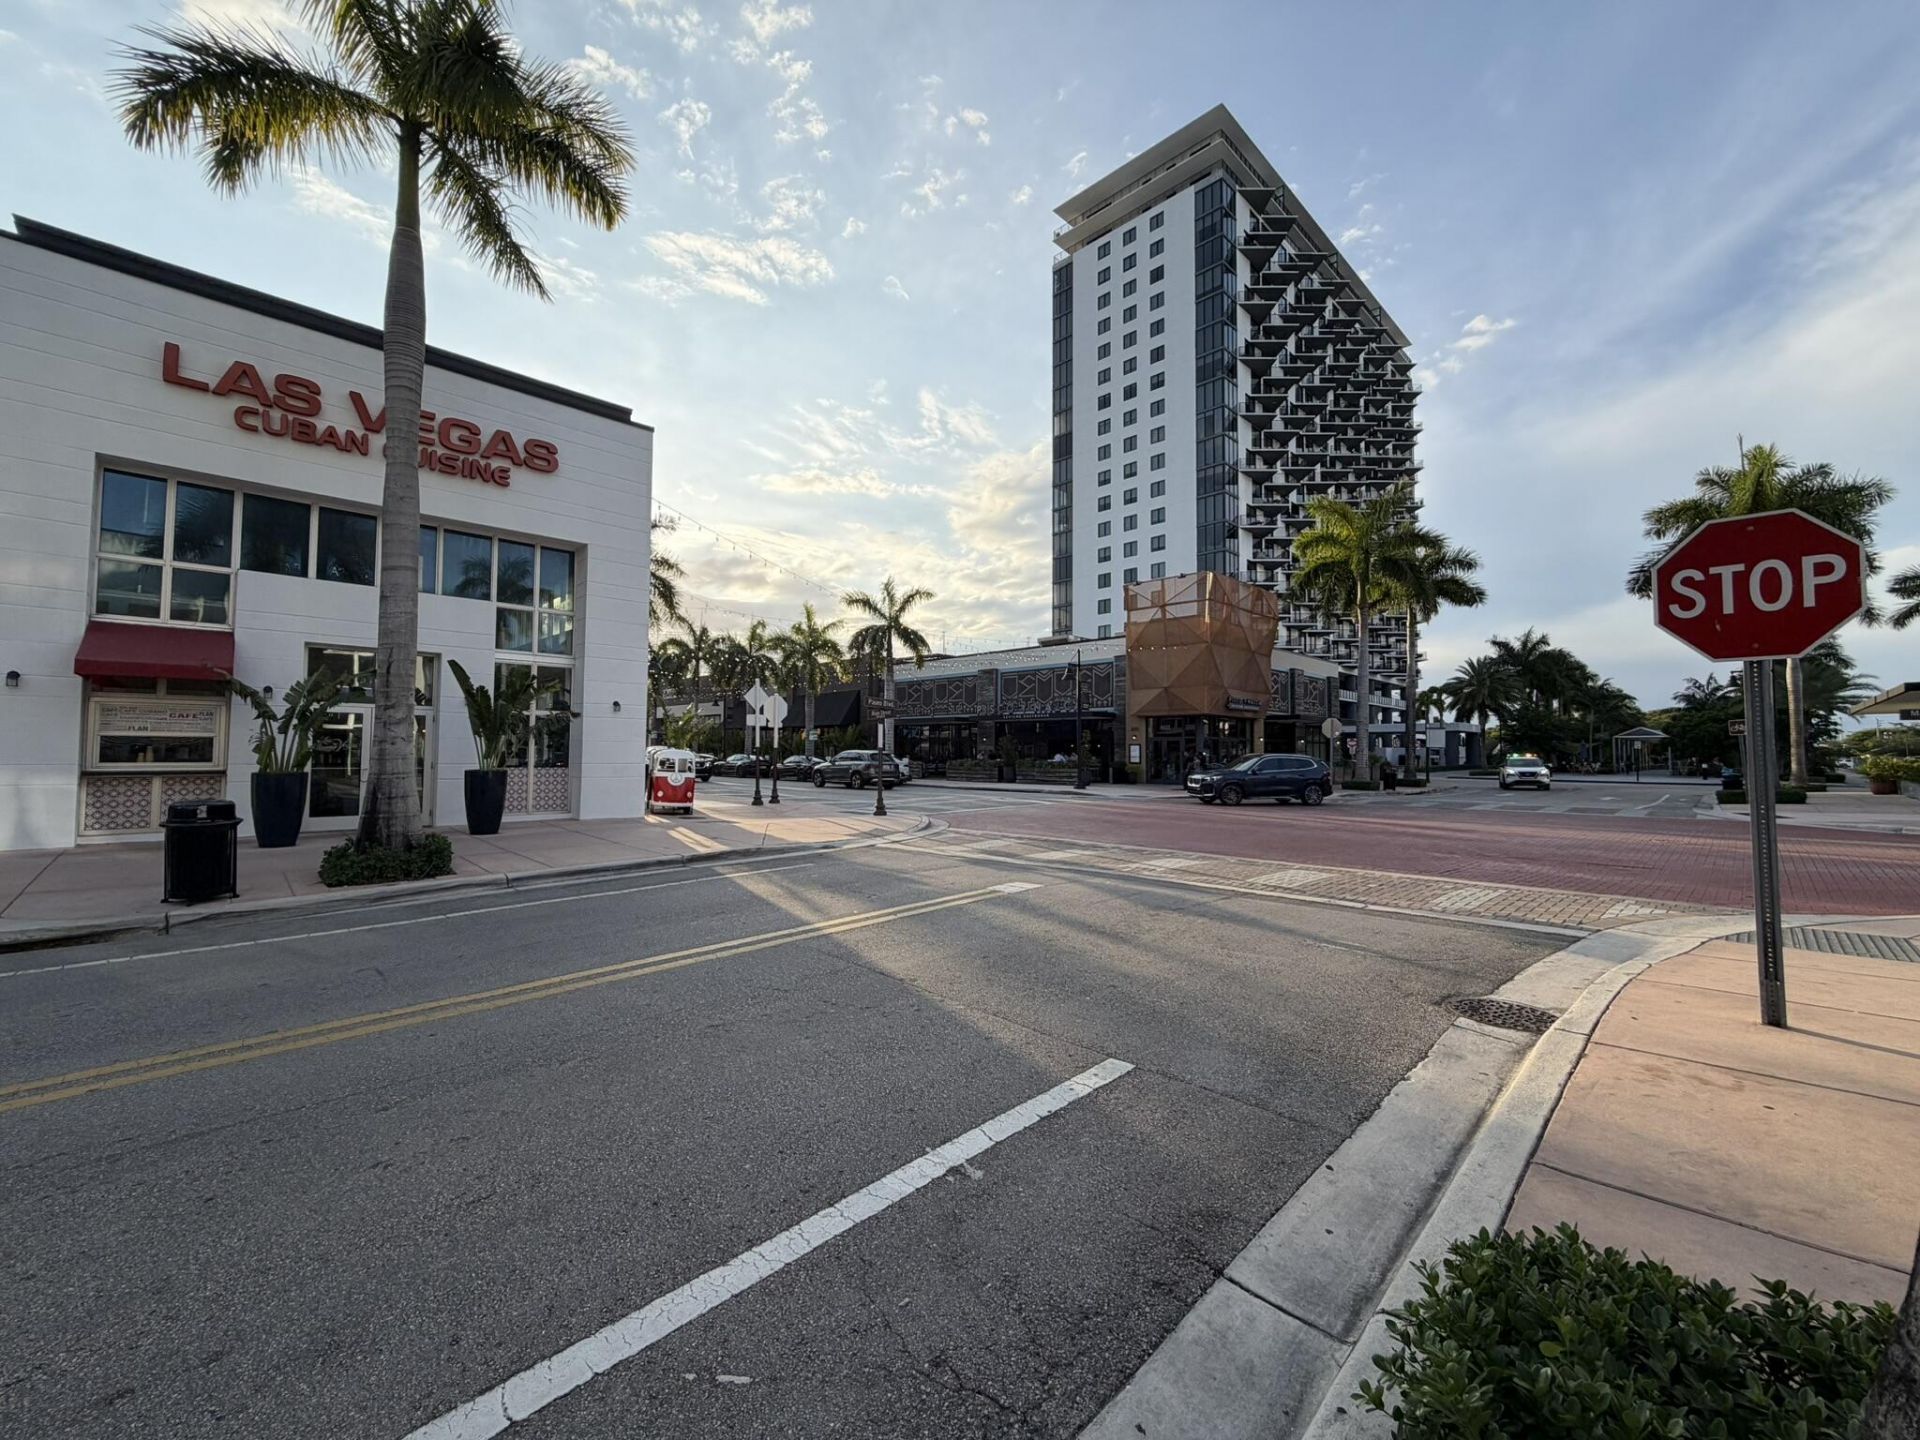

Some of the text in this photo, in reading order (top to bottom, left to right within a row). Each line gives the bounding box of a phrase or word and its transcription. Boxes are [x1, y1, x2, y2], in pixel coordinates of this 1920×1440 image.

[162, 341, 560, 474] LAS VEGAS
[234, 405, 511, 487] CUBAN ISINE
[1668, 554, 1847, 619] STOP
